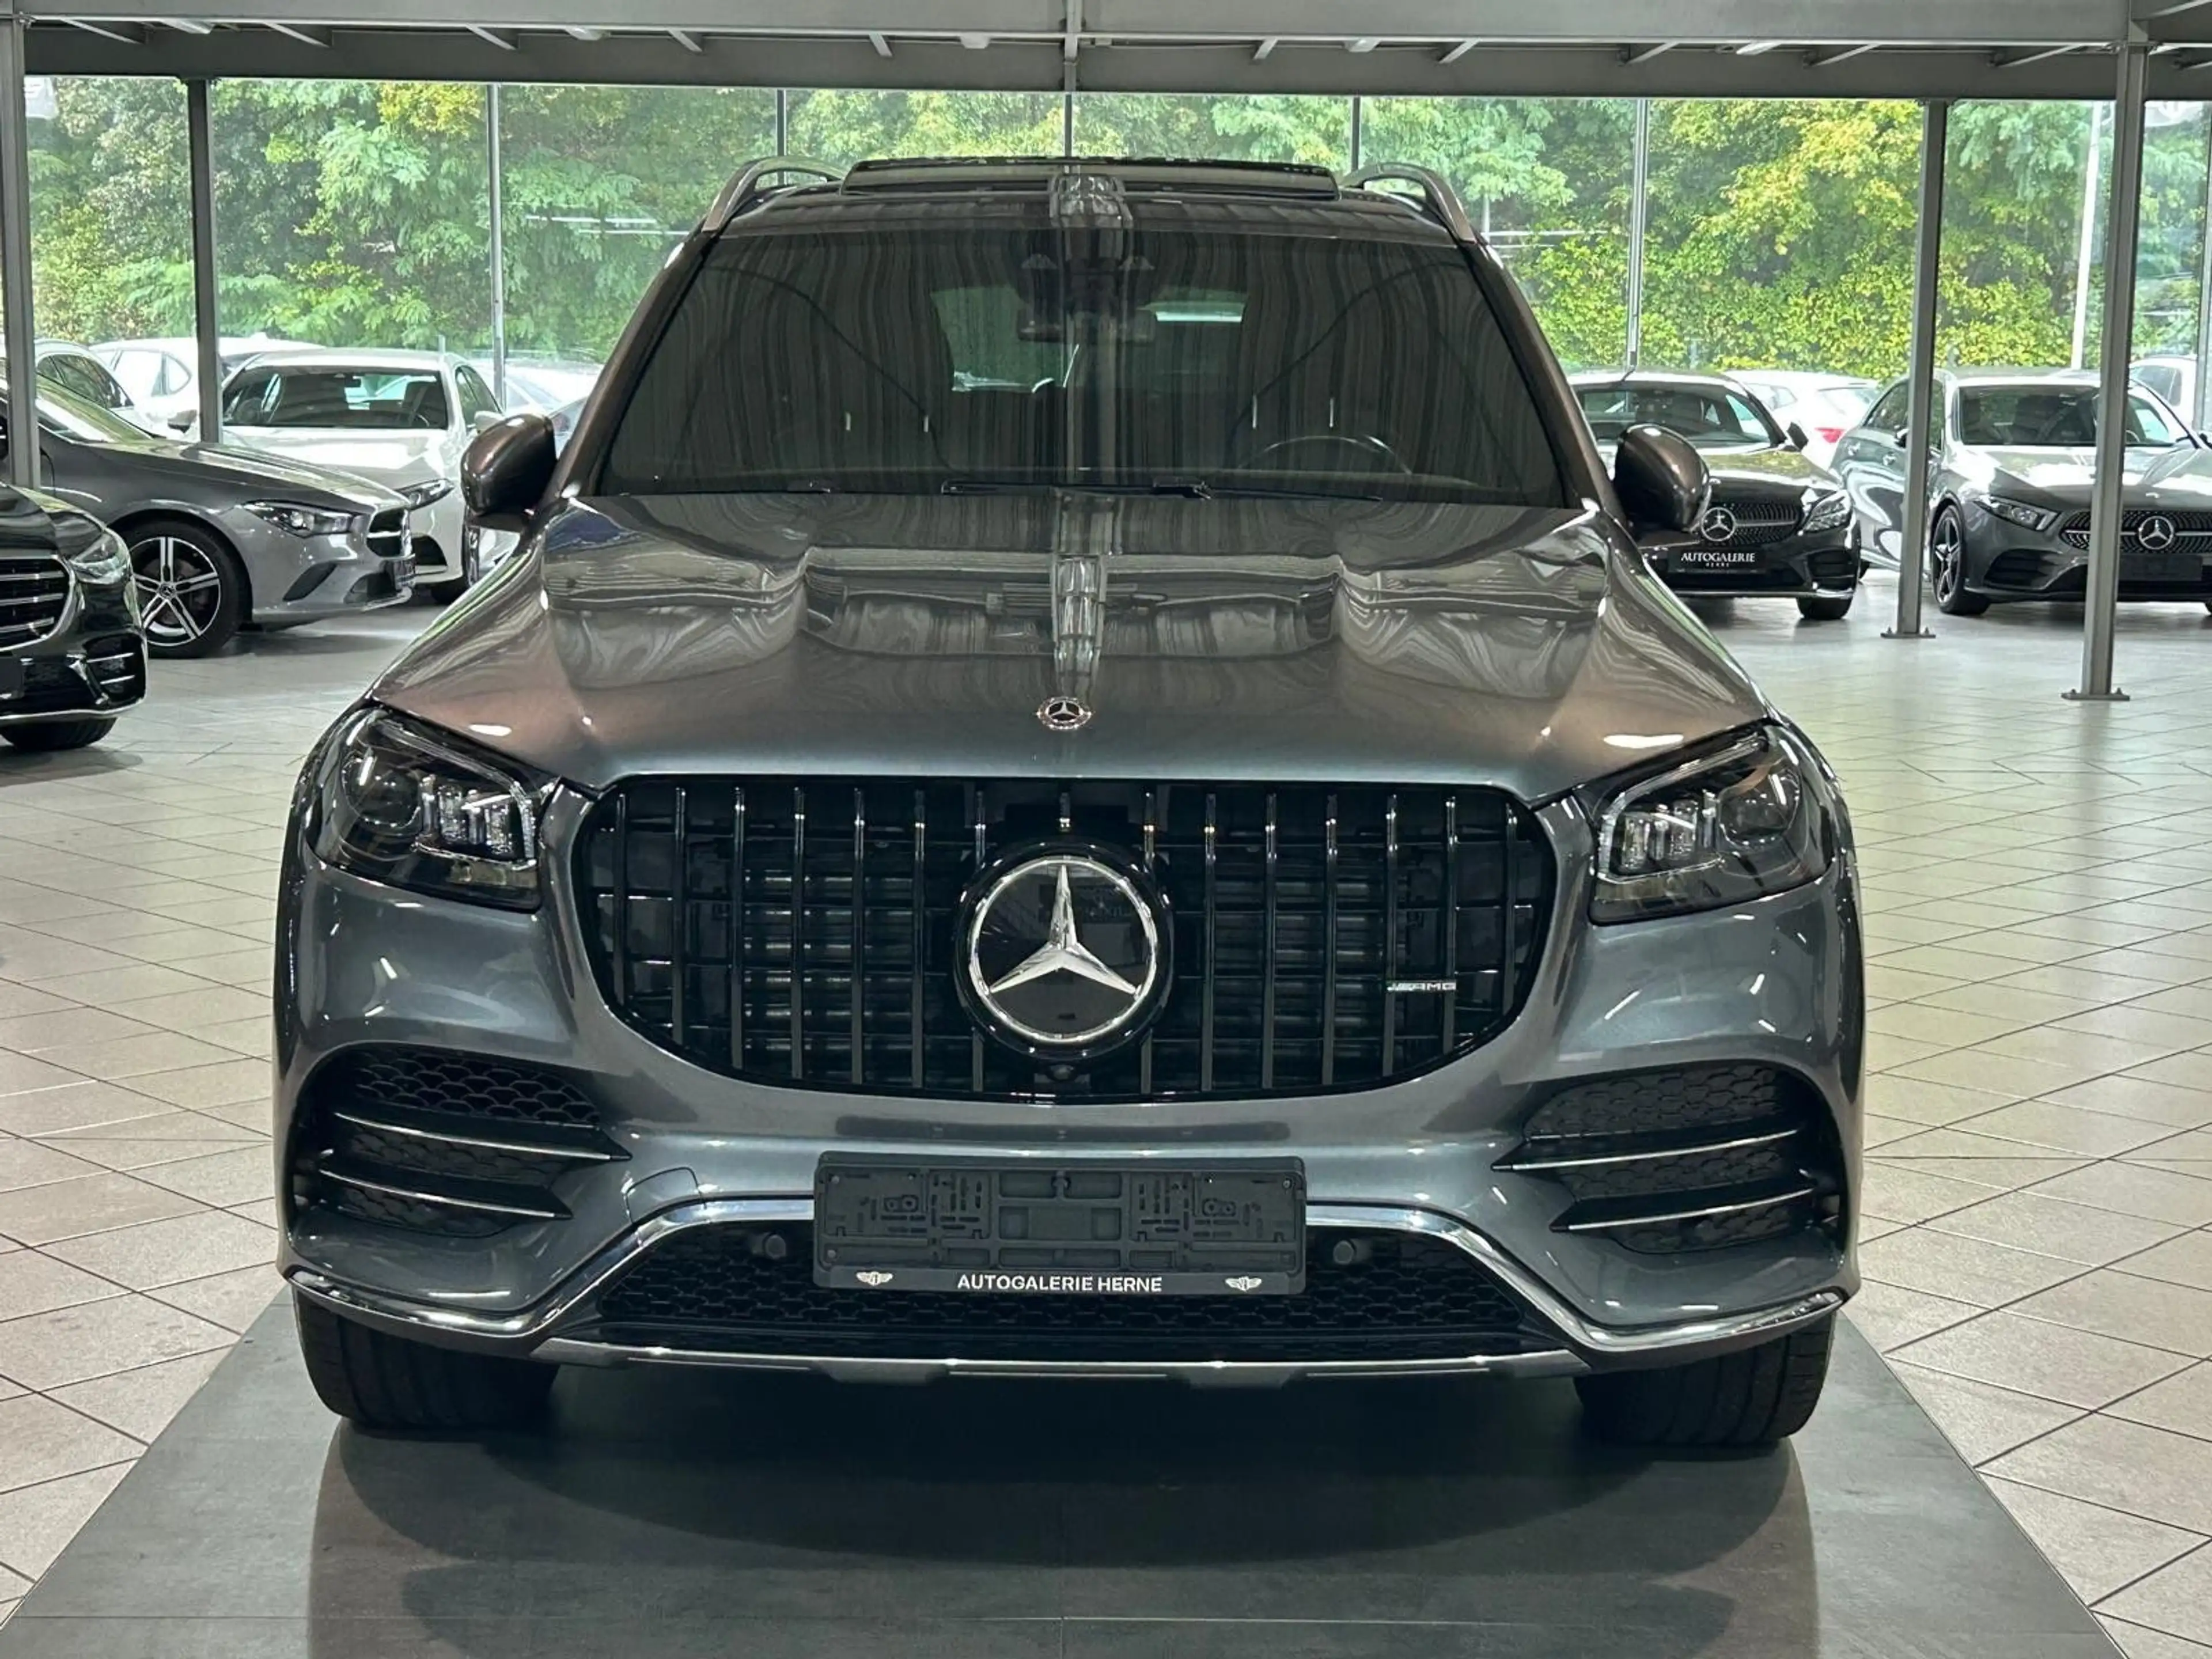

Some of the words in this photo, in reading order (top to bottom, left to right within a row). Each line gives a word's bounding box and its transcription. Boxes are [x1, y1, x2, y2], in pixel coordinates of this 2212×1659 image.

[1680, 552, 1755, 562] AUTOGALERIE
[957, 1274, 1093, 1291] AUTOGALERIE
[1097, 1276, 1162, 1293] HERNE
